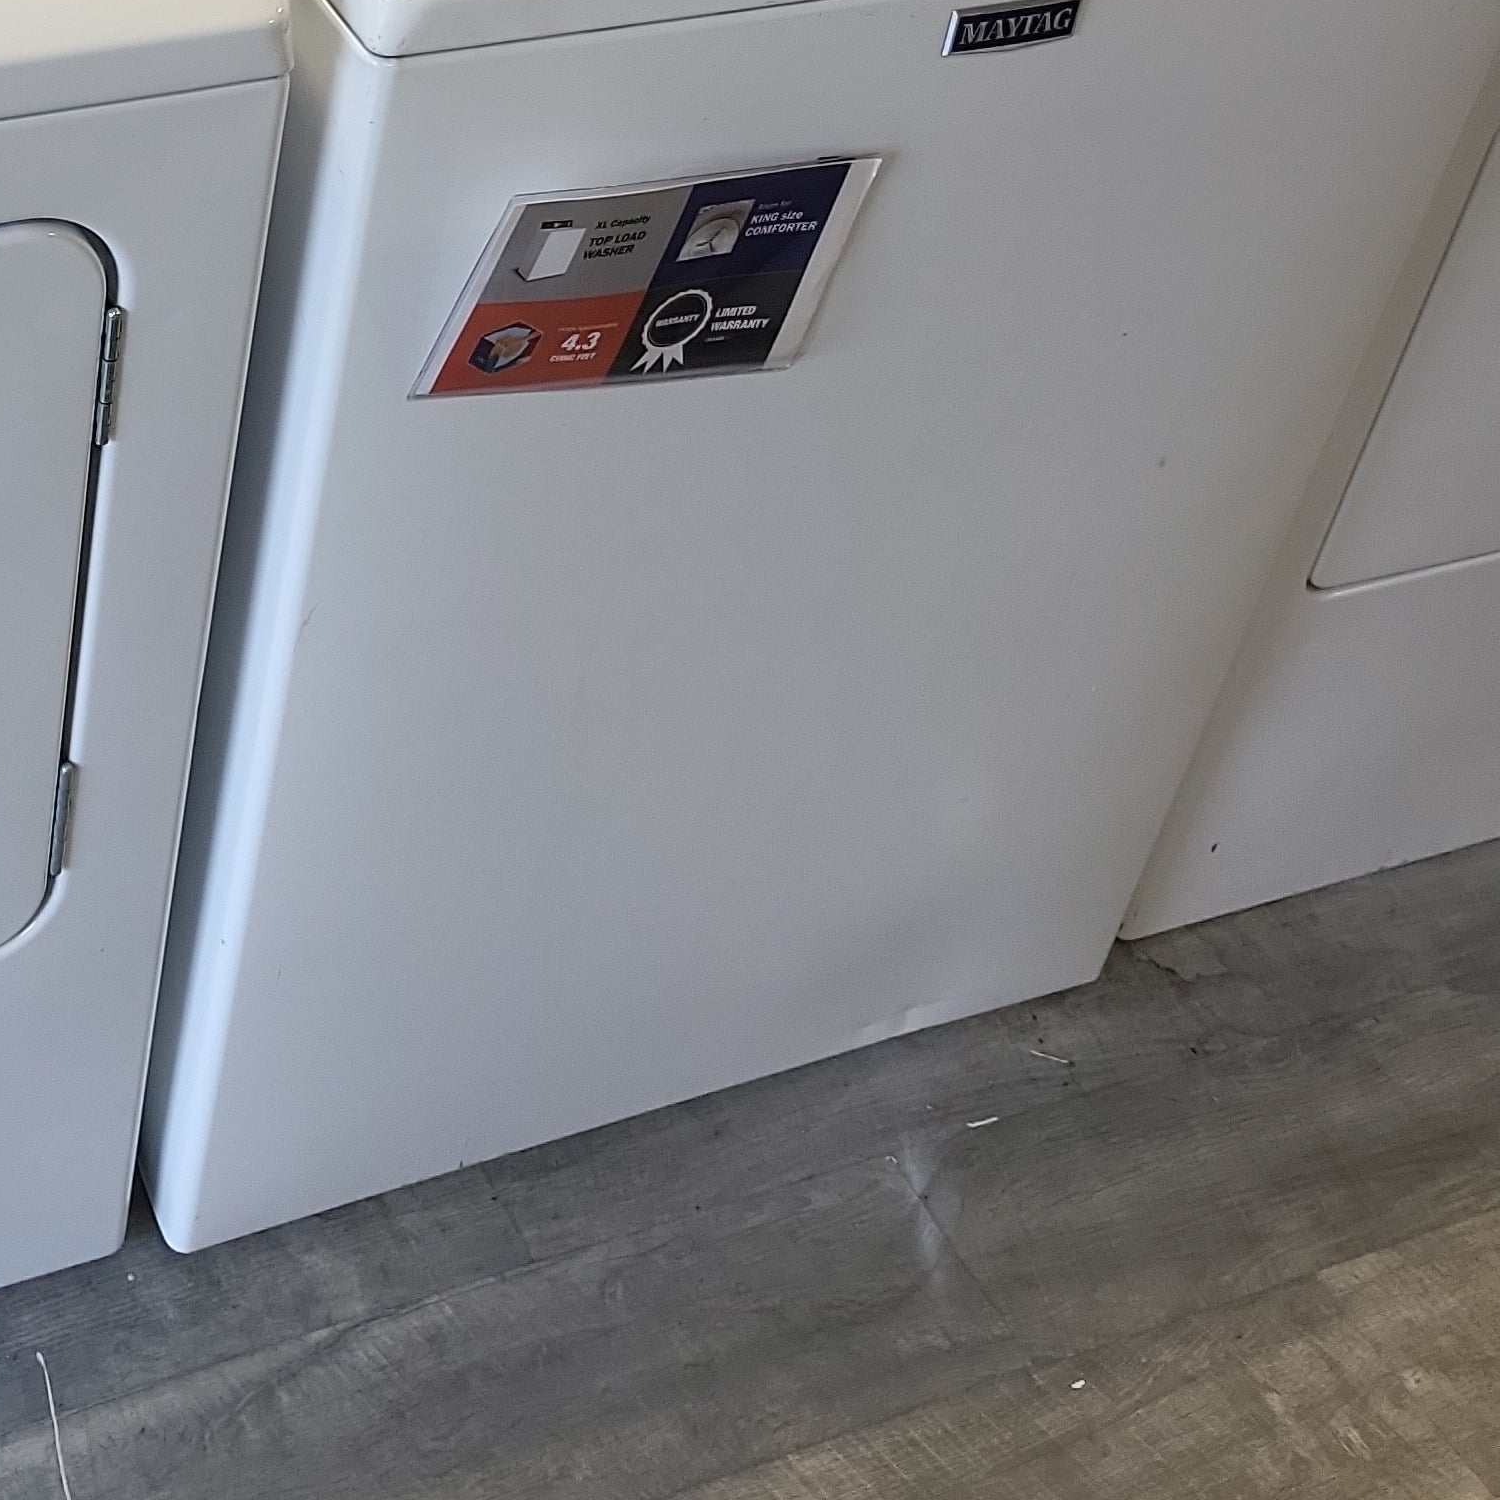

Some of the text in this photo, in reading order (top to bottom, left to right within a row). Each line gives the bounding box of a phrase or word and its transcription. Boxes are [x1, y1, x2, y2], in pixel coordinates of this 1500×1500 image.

[958, 6, 1073, 46] MAYTAG
[610, 215, 652, 228] Capacity
[750, 209, 804, 224] KING size
[744, 220, 818, 237] COMFORTER
[588, 230, 647, 248] TOP LOAD
[583, 243, 636, 260] WASHER
[715, 305, 757, 318] LIMITED
[655, 313, 701, 327] WARRANTY
[710, 317, 771, 332] WARRANTY
[560, 331, 601, 352] 4.3
